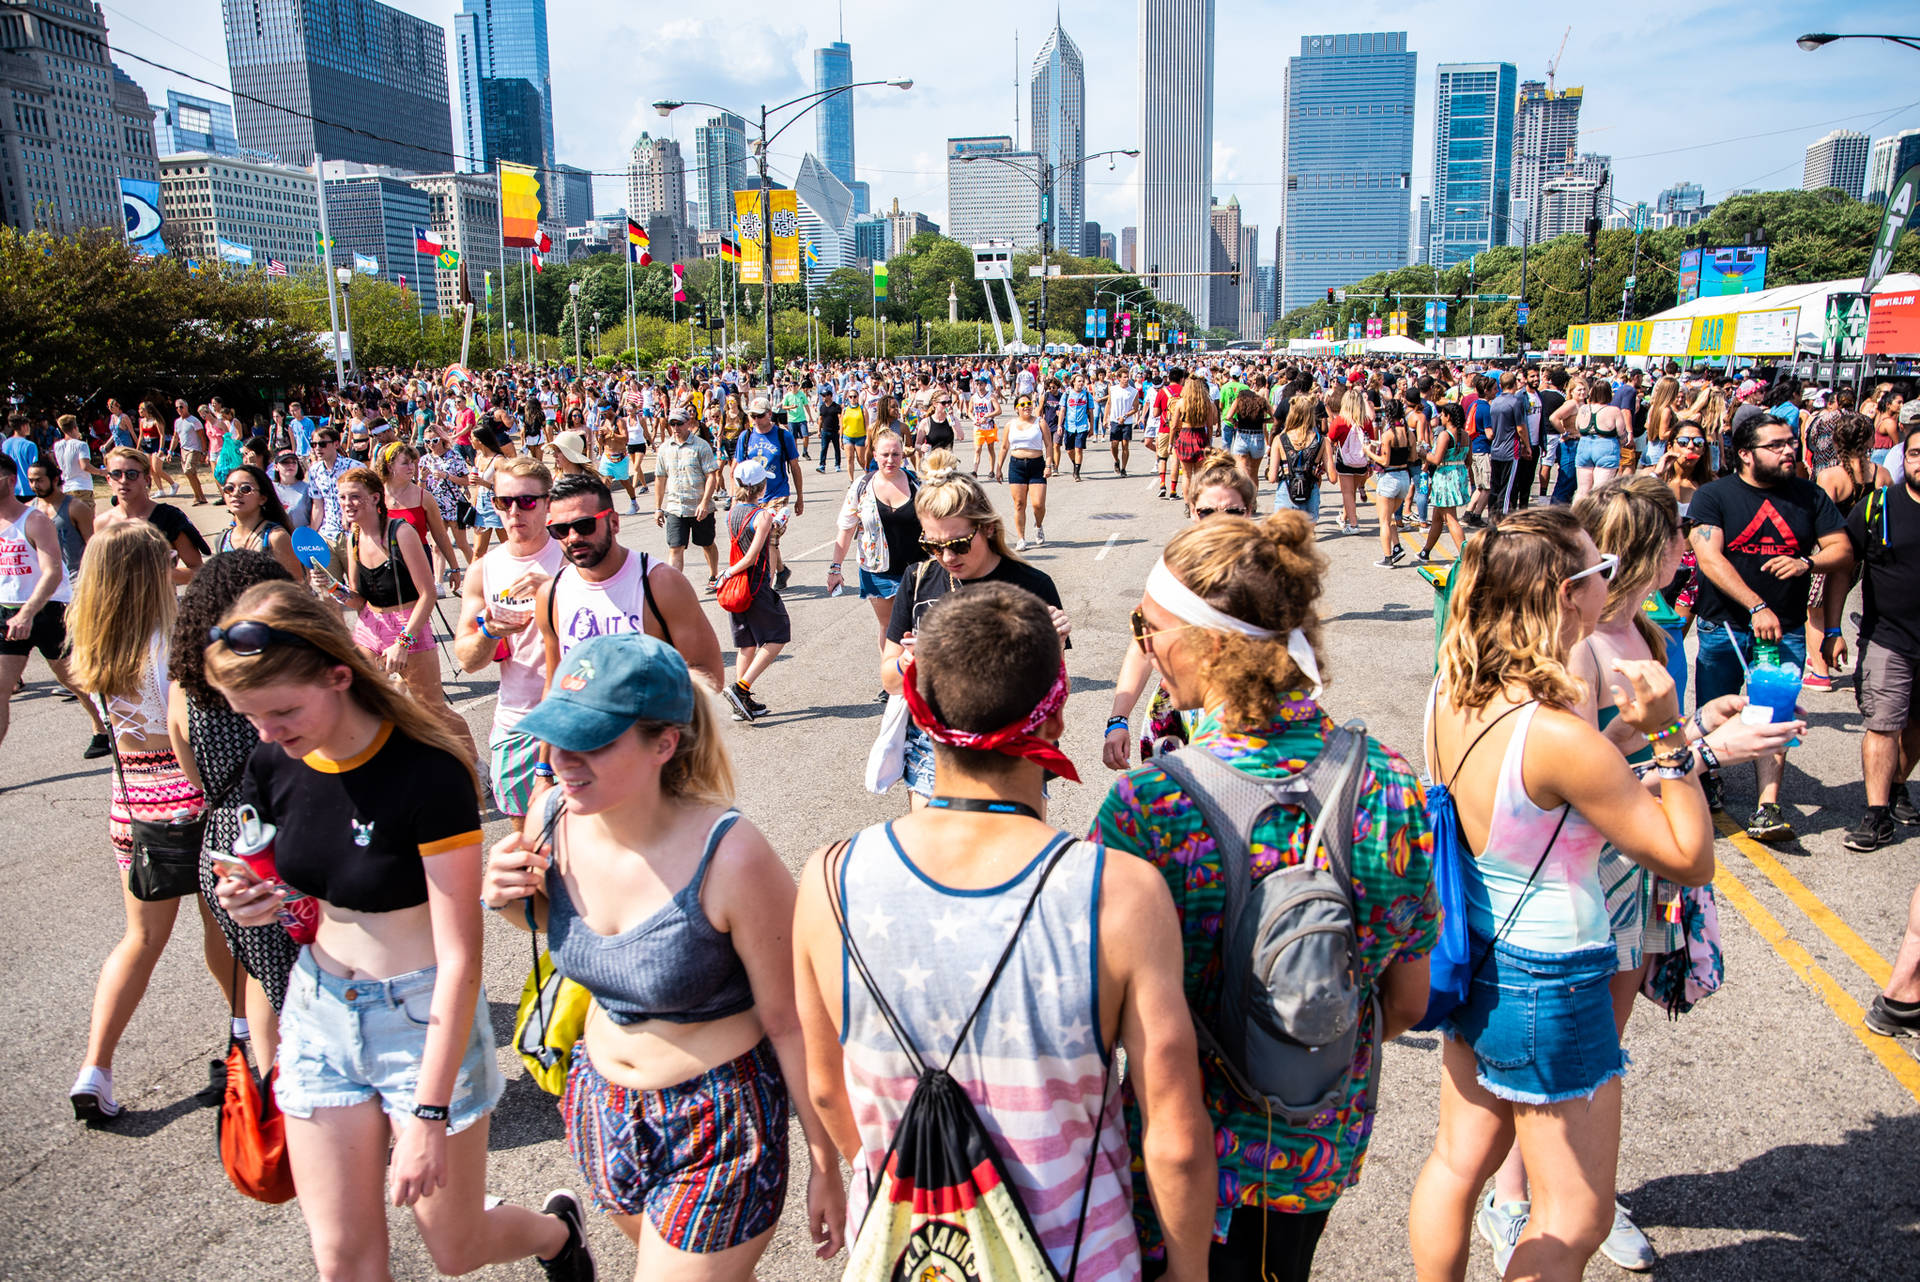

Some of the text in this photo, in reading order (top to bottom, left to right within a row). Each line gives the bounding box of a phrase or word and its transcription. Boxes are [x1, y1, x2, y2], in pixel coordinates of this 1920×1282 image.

[1624, 324, 1643, 352] BAR
[1700, 318, 1724, 351] BAR
[1841, 298, 1867, 357] ATM
[1729, 543, 1796, 556] ACHILLES
[606, 611, 640, 635] IT'S
